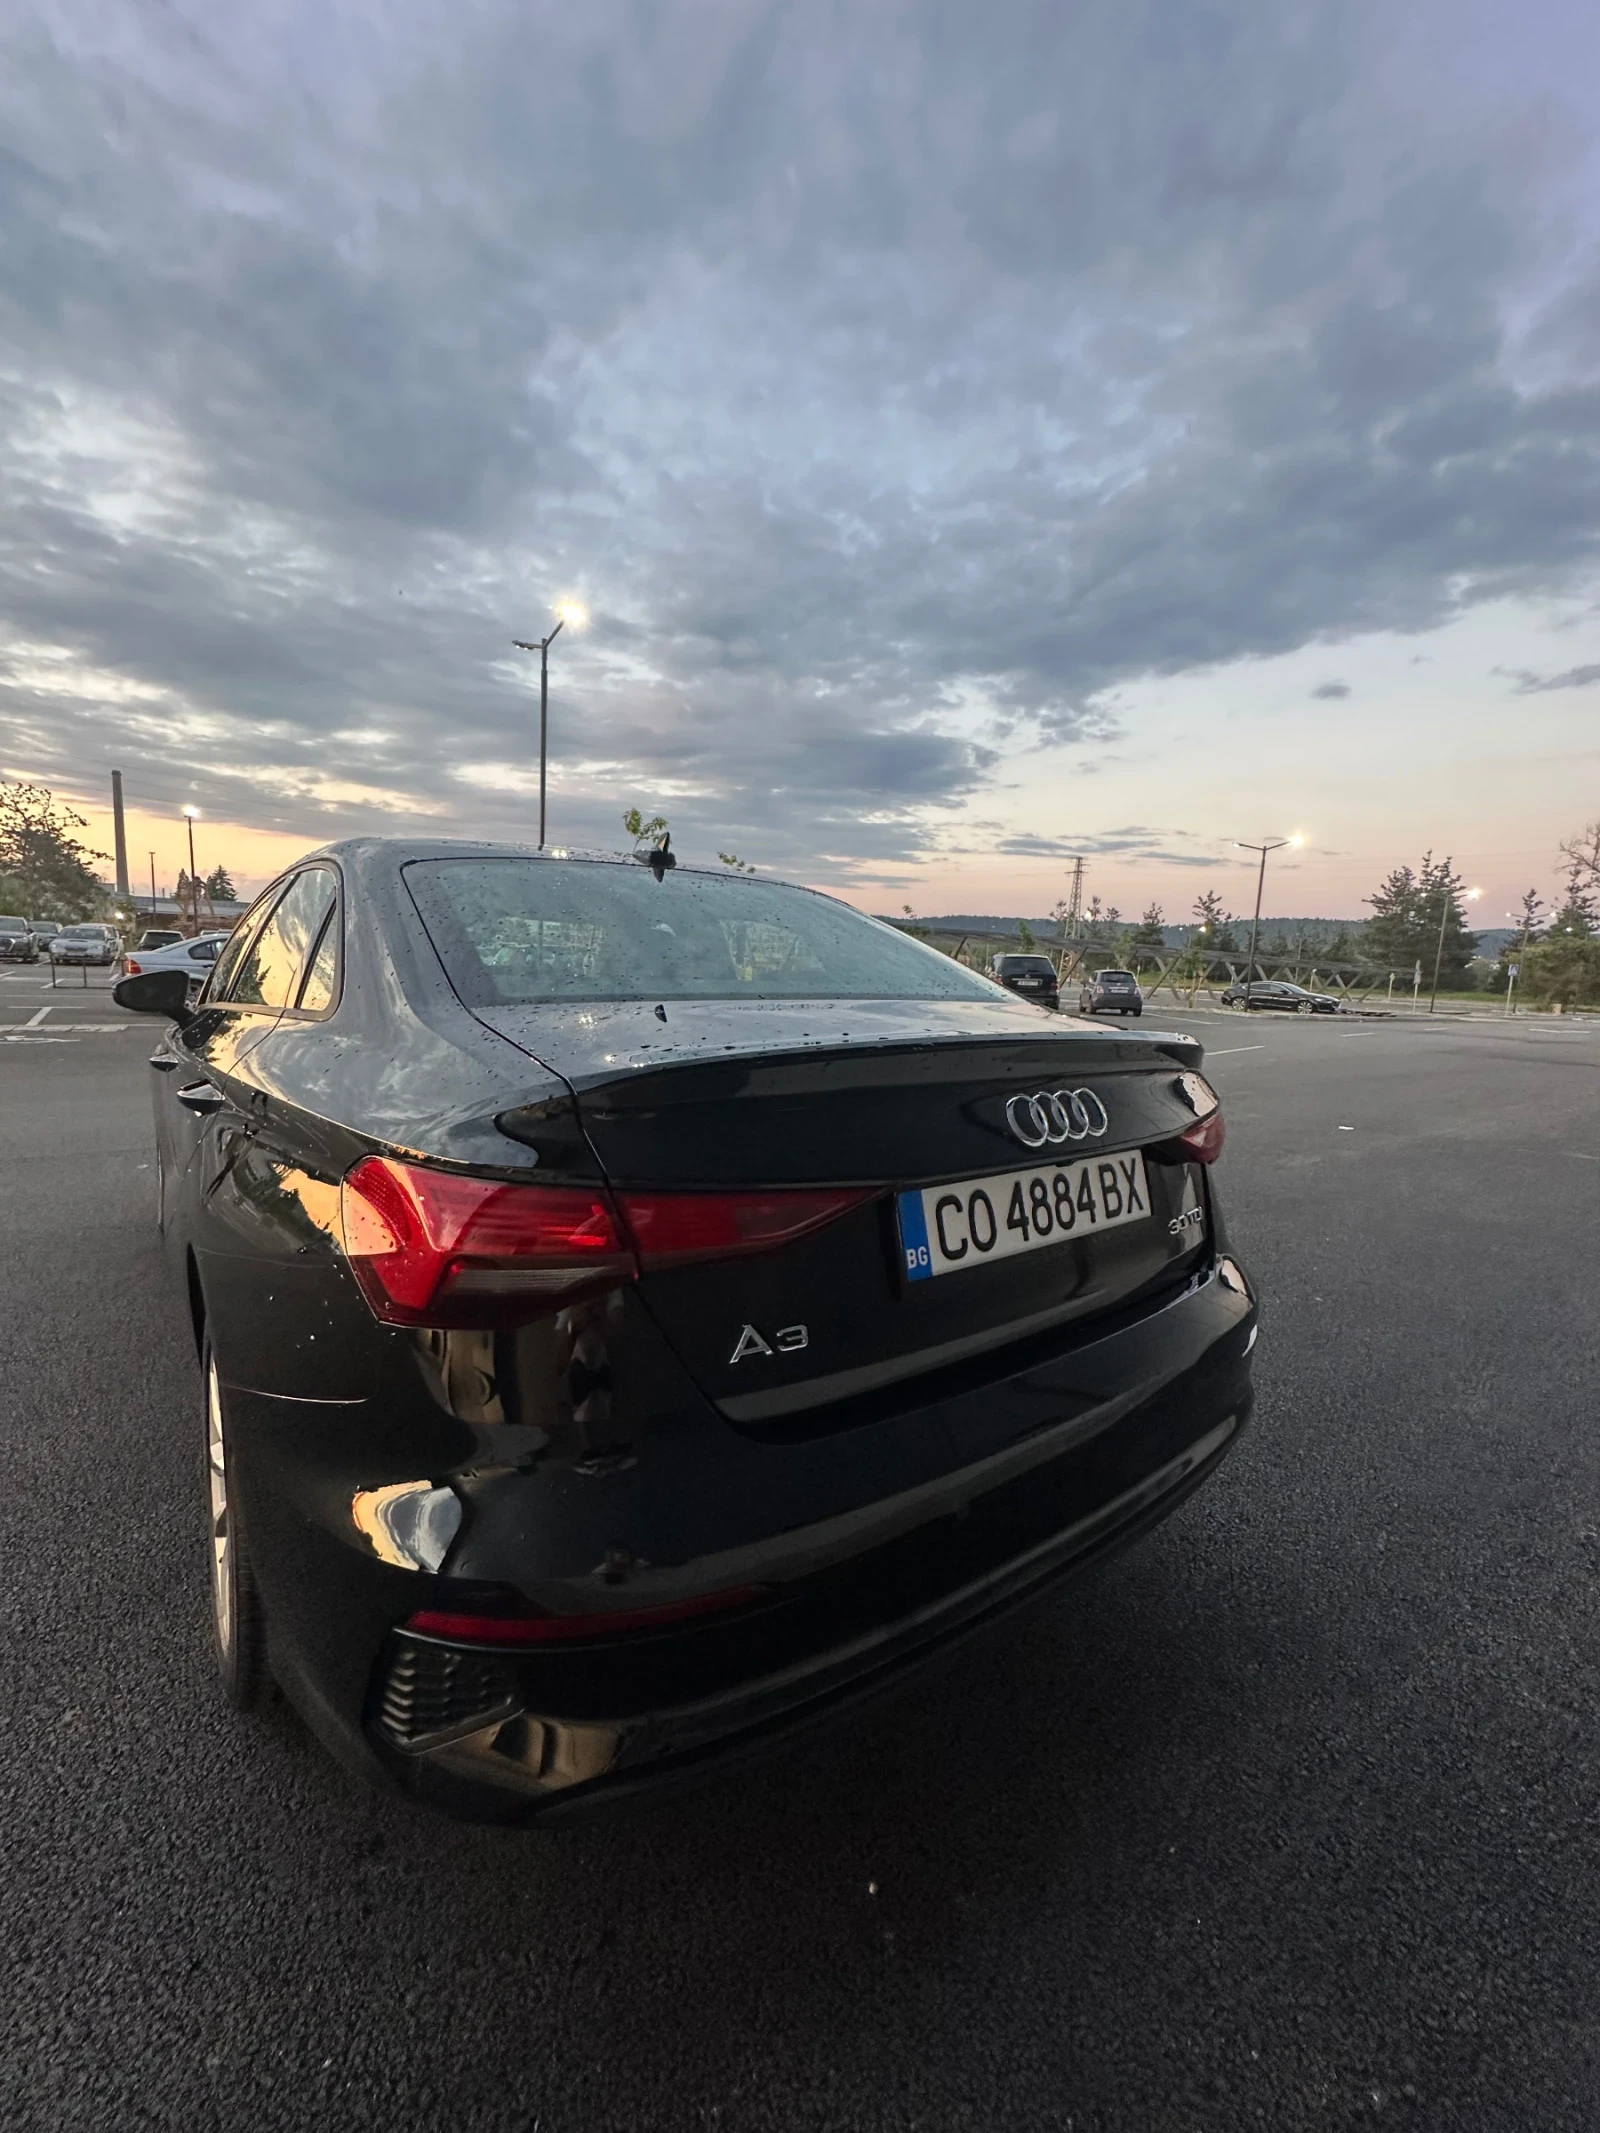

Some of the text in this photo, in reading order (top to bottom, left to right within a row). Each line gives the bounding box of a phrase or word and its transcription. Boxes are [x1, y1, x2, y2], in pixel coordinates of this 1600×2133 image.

[935, 1157, 1144, 1261] CO 4884 BX
[905, 1245, 928, 1269] BG
[728, 1324, 809, 1364] A3
